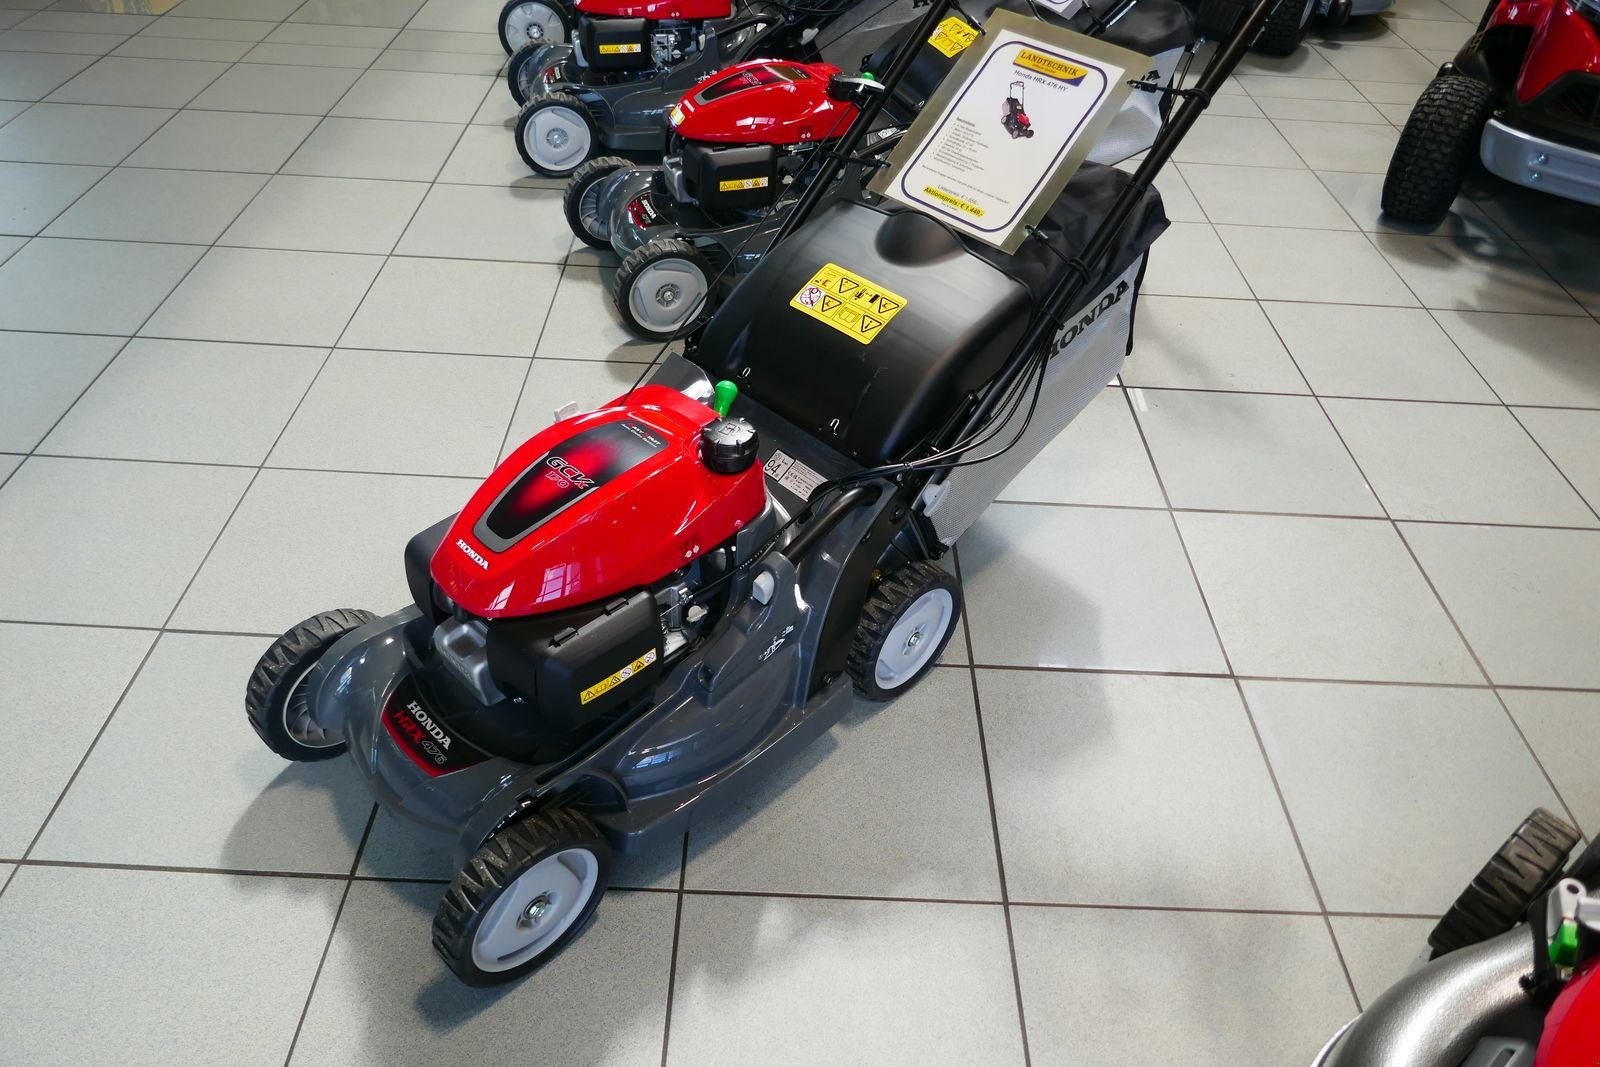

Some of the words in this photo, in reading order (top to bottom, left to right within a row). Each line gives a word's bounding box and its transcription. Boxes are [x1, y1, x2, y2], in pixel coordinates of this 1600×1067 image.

[1021, 52, 1079, 76] LANDTECHNIK
[1014, 69, 1033, 80] Honda
[1033, 75, 1046, 84] HRX
[924, 186, 961, 207] Aktionspreis:
[764, 459, 782, 476] 94
[545, 471, 570, 489] 170
[456, 538, 490, 571] HONDA
[406, 700, 452, 750] HONDA
[393, 710, 429, 745] HRX
[421, 740, 448, 765] 476
